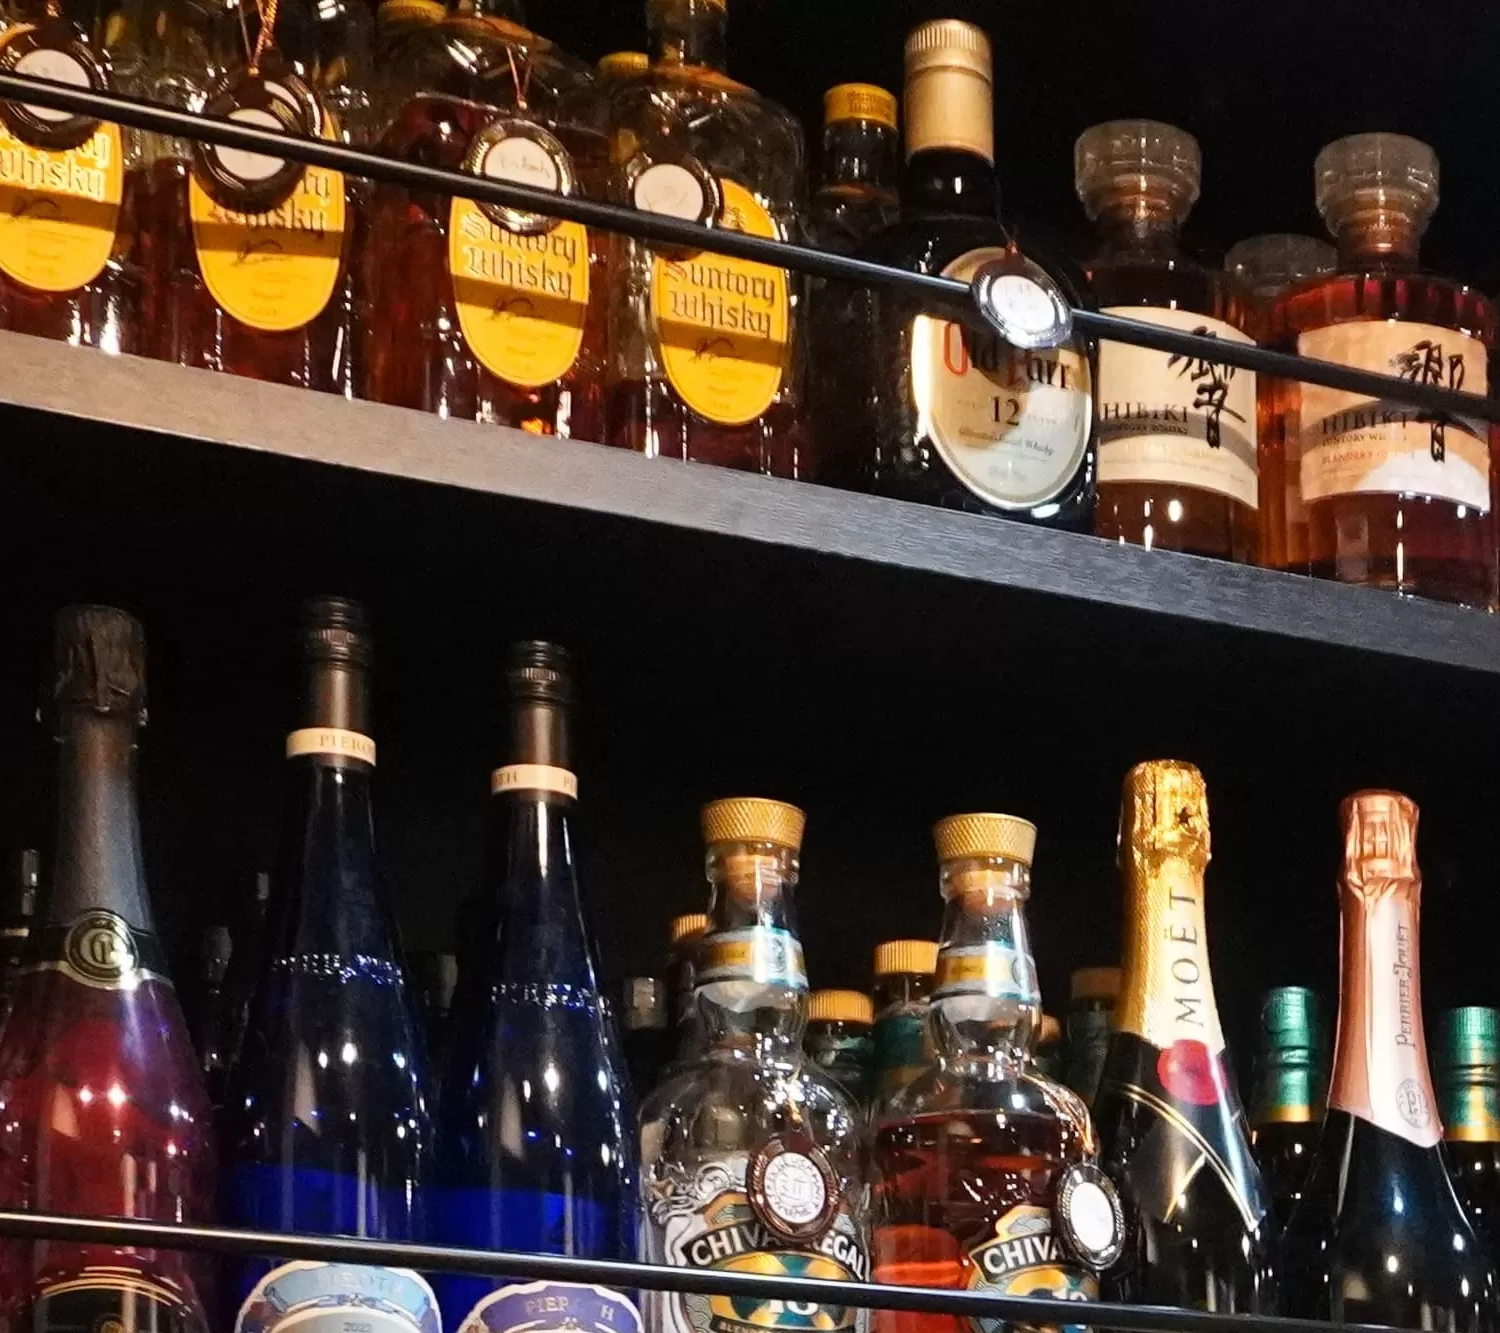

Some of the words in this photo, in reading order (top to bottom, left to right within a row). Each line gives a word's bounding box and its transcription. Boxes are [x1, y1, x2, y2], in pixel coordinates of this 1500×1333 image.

[464, 244, 572, 298] Whisky
[664, 255, 776, 306] Suntory
[670, 289, 772, 338] Whisky
[991, 395, 1021, 427] 12
[1103, 402, 1189, 424] HIBIKI
[1322, 409, 1408, 434] HIBIKI
[1163, 886, 1206, 1029] MOËT
[690, 1222, 780, 1267] CHIVA
[817, 1229, 866, 1281] EGAL
[983, 1234, 1068, 1275] CHIVA
[524, 1295, 615, 1323] PIERH
